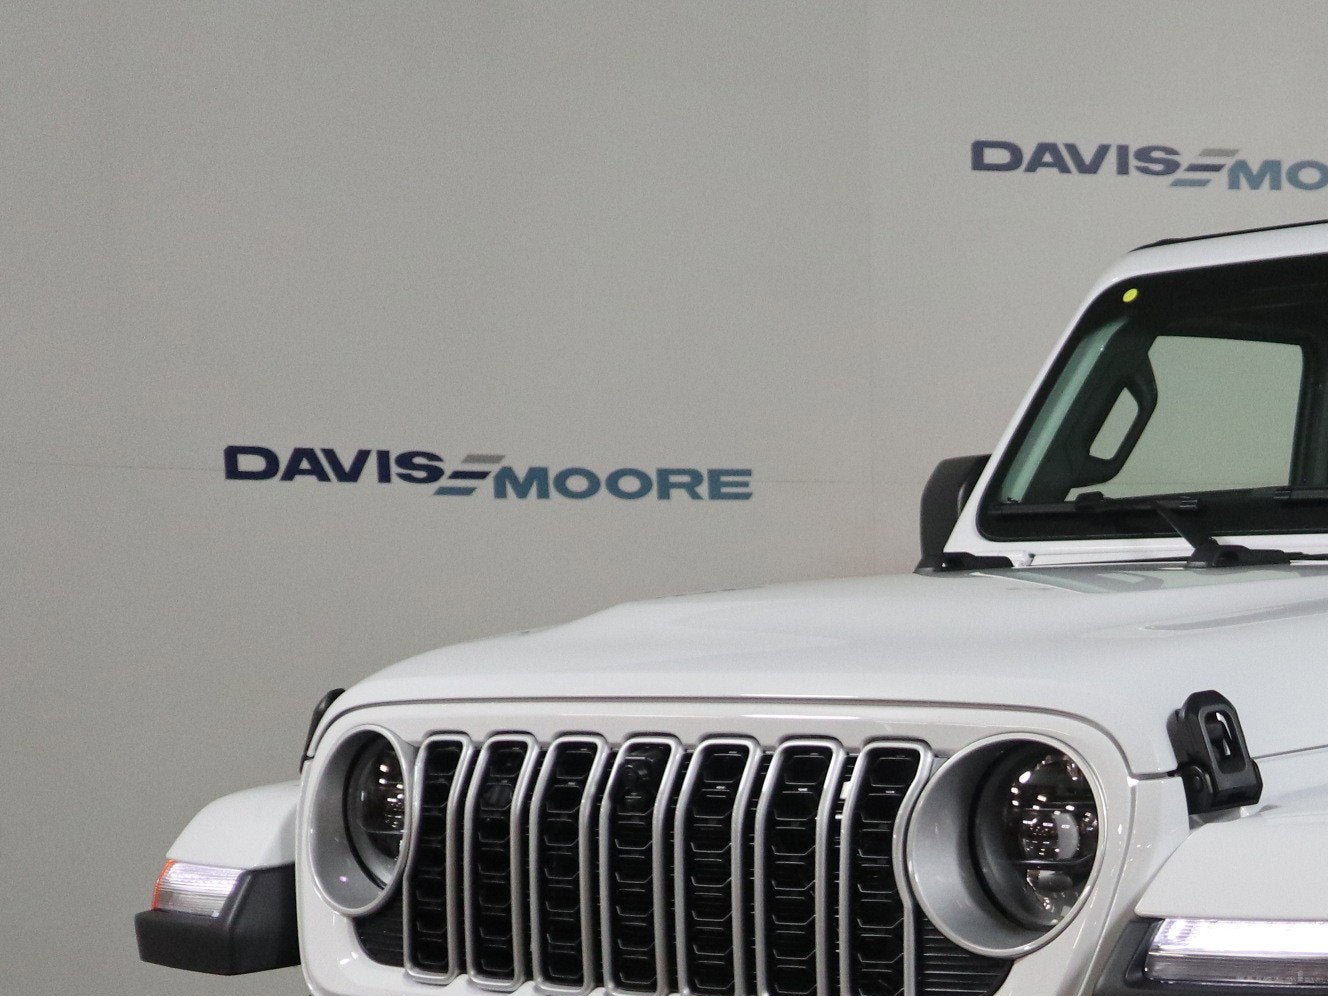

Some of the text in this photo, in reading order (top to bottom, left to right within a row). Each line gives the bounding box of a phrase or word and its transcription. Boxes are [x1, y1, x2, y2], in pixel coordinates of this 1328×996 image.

[971, 140, 1181, 176] DAVIS
[223, 445, 753, 501] DAVIS MOORE
